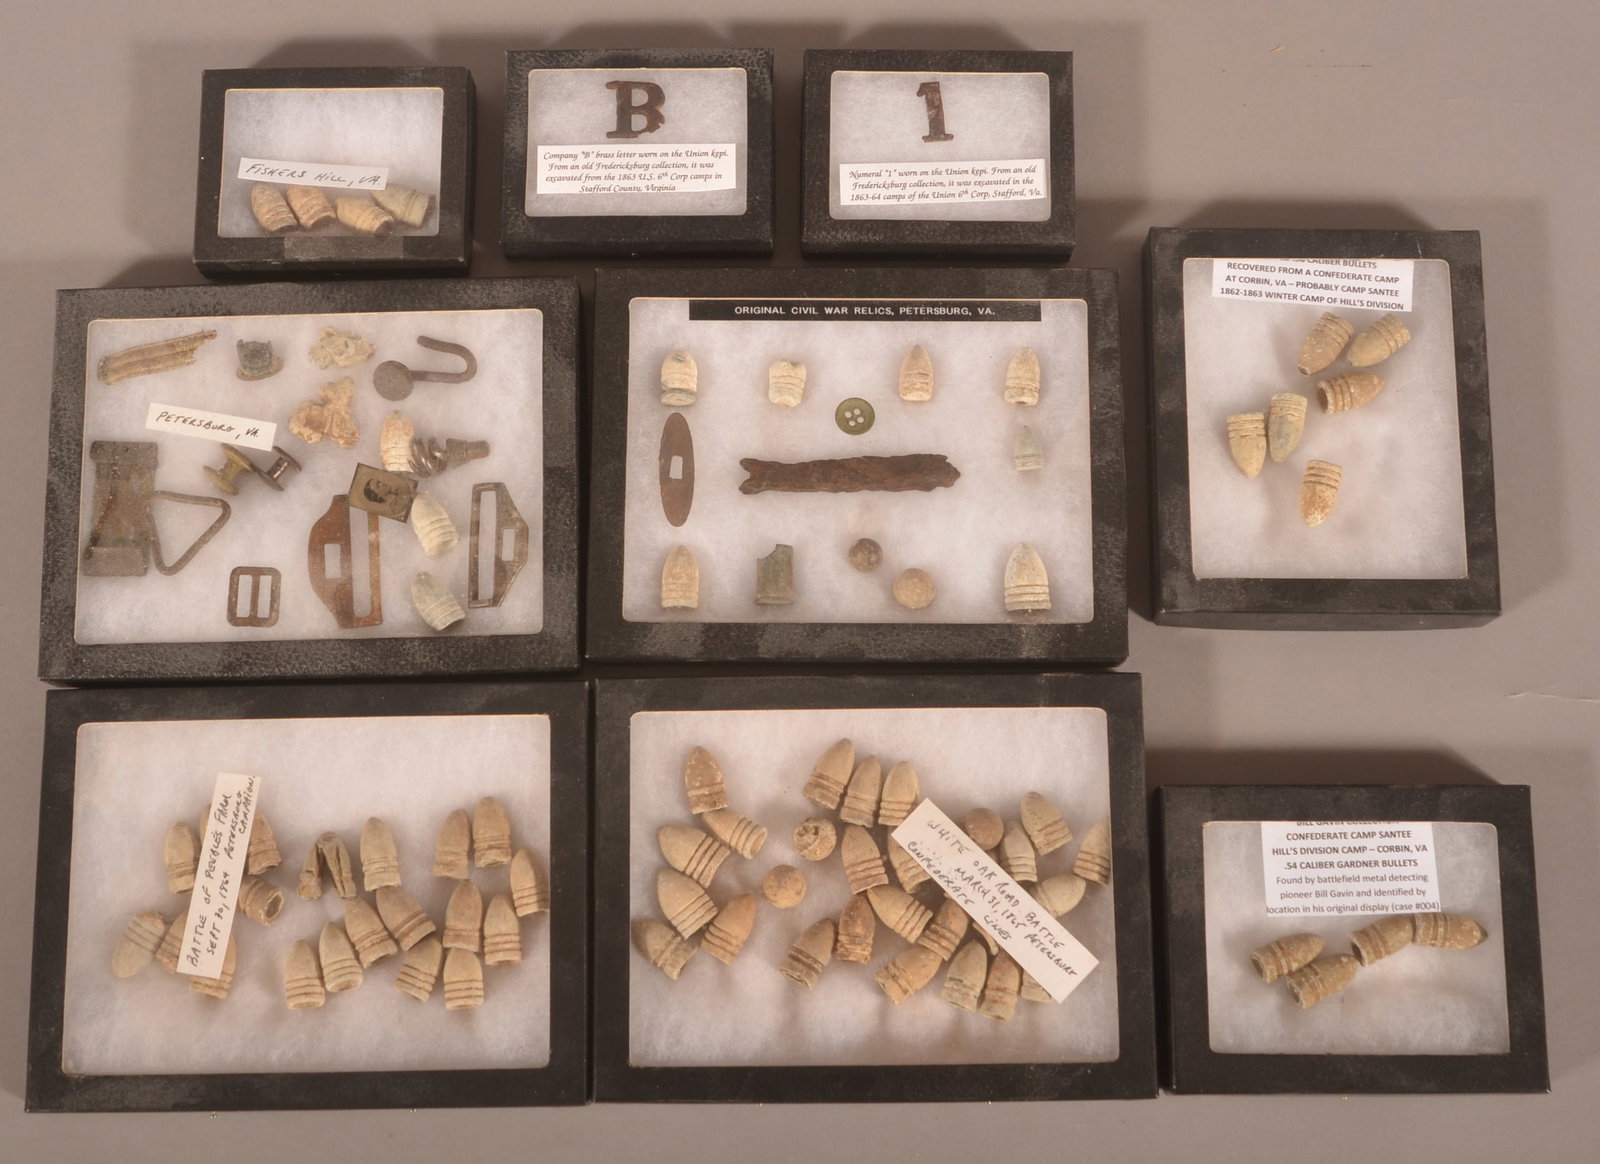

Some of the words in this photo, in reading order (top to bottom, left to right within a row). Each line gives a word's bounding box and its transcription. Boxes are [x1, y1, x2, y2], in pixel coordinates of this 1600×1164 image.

[605, 80, 666, 139] B
[543, 151, 578, 161] Company
[595, 151, 615, 159] brass
[616, 150, 636, 158] letter
[671, 148, 683, 157] the
[685, 150, 709, 158] Union
[711, 148, 729, 159] kepi.
[246, 163, 307, 178] FISHERS
[548, 162, 568, 172] From
[581, 161, 594, 170] old
[595, 160, 650, 172] Fredericksburg
[651, 160, 689, 169] collection,
[691, 161, 697, 169] it
[849, 169, 882, 179] Numeral
[931, 167, 942, 176] the
[945, 167, 969, 176] Union
[971, 166, 989, 177] kepi.
[991, 166, 1011, 175] From
[1024, 164, 1037, 174] old
[545, 173, 583, 183] excavated
[583, 172, 602, 183] from
[604, 173, 616, 181] the
[617, 173, 636, 181] 1863
[670, 172, 688, 182] Corp
[689, 173, 713, 183] camps
[852, 180, 907, 191] Fredericksburg
[908, 179, 946, 188] collection,
[948, 179, 954, 187] it
[973, 177, 1011, 188] excavated
[1012, 177, 1020, 185] in
[1022, 176, 1034, 185] the
[579, 184, 612, 193] Stafford
[645, 183, 676, 192] Virginia
[850, 193, 881, 202] 1863-64
[882, 193, 906, 203] camps
[907, 190, 916, 202] of
[917, 190, 930, 199] the
[931, 191, 956, 199] Union
[992, 187, 1027, 199] Stafford,
[1028, 187, 1043, 196] Va.
[1342, 258, 1377, 269] BULLETS
[1227, 262, 1276, 273] RECOVERED
[1278, 266, 1304, 275] FROM
[1313, 269, 1373, 282] CONFEDERATE
[1374, 275, 1400, 284] CAMP
[1238, 276, 1273, 287] CORBIN,
[1275, 279, 1287, 287] VA
[1295, 281, 1340, 292] PROBABLY
[1341, 285, 1366, 294] CAMP
[1367, 287, 1400, 297] SANTEE
[1220, 287, 1263, 298] 1862-1863
[1264, 291, 1298, 301] WINTER
[1299, 294, 1325, 303] CAMP
[1326, 296, 1338, 304] OF
[1366, 300, 1404, 310] DIVISION
[734, 306, 786, 315] ORIGINAL
[791, 306, 819, 315] CIVIL
[824, 306, 848, 315] WAR
[854, 306, 894, 316] RELICS,
[899, 306, 972, 316] PETERSBURG,
[977, 307, 996, 315] VA.
[1286, 832, 1348, 841] CONFEDERATE
[1350, 831, 1377, 839] CAMP
[1378, 830, 1412, 839] SANTEE
[1300, 846, 1339, 855] DIVISION
[1341, 845, 1367, 854] CAMP
[1377, 844, 1414, 853] CORBIN,
[1414, 844, 1428, 852] VA
[1284, 862, 1298, 870] .54
[1299, 861, 1335, 870] CALIBER
[1336, 859, 1380, 869] GARDNER
[1381, 859, 1419, 868] BULLETS
[1276, 875, 1303, 884] Found
[1304, 875, 1315, 885] by
[1317, 874, 1360, 884] battlefield
[1362, 873, 1387, 882] metal
[1388, 873, 1429, 883] detecting
[1280, 891, 1312, 900] pioneer
[1315, 889, 1328, 898] Bill
[1329, 889, 1354, 898] Gavin
[1355, 889, 1372, 897] and
[1373, 887, 1414, 896] identified
[1416, 887, 1427, 897] by
[973, 860, 997, 881] OAK
[1025, 911, 1065, 949] BATTLE
[1266, 905, 1301, 914] location
[1302, 904, 1311, 913] in
[1312, 904, 1325, 913] his
[1326, 903, 1358, 914] original
[1360, 902, 1389, 913] display
[1391, 902, 1414, 912] (case
[1415, 900, 1440, 911] #004)
[186, 914, 207, 967] BATTLE
[201, 885, 212, 905] OF
[207, 922, 221, 955] SEPT
